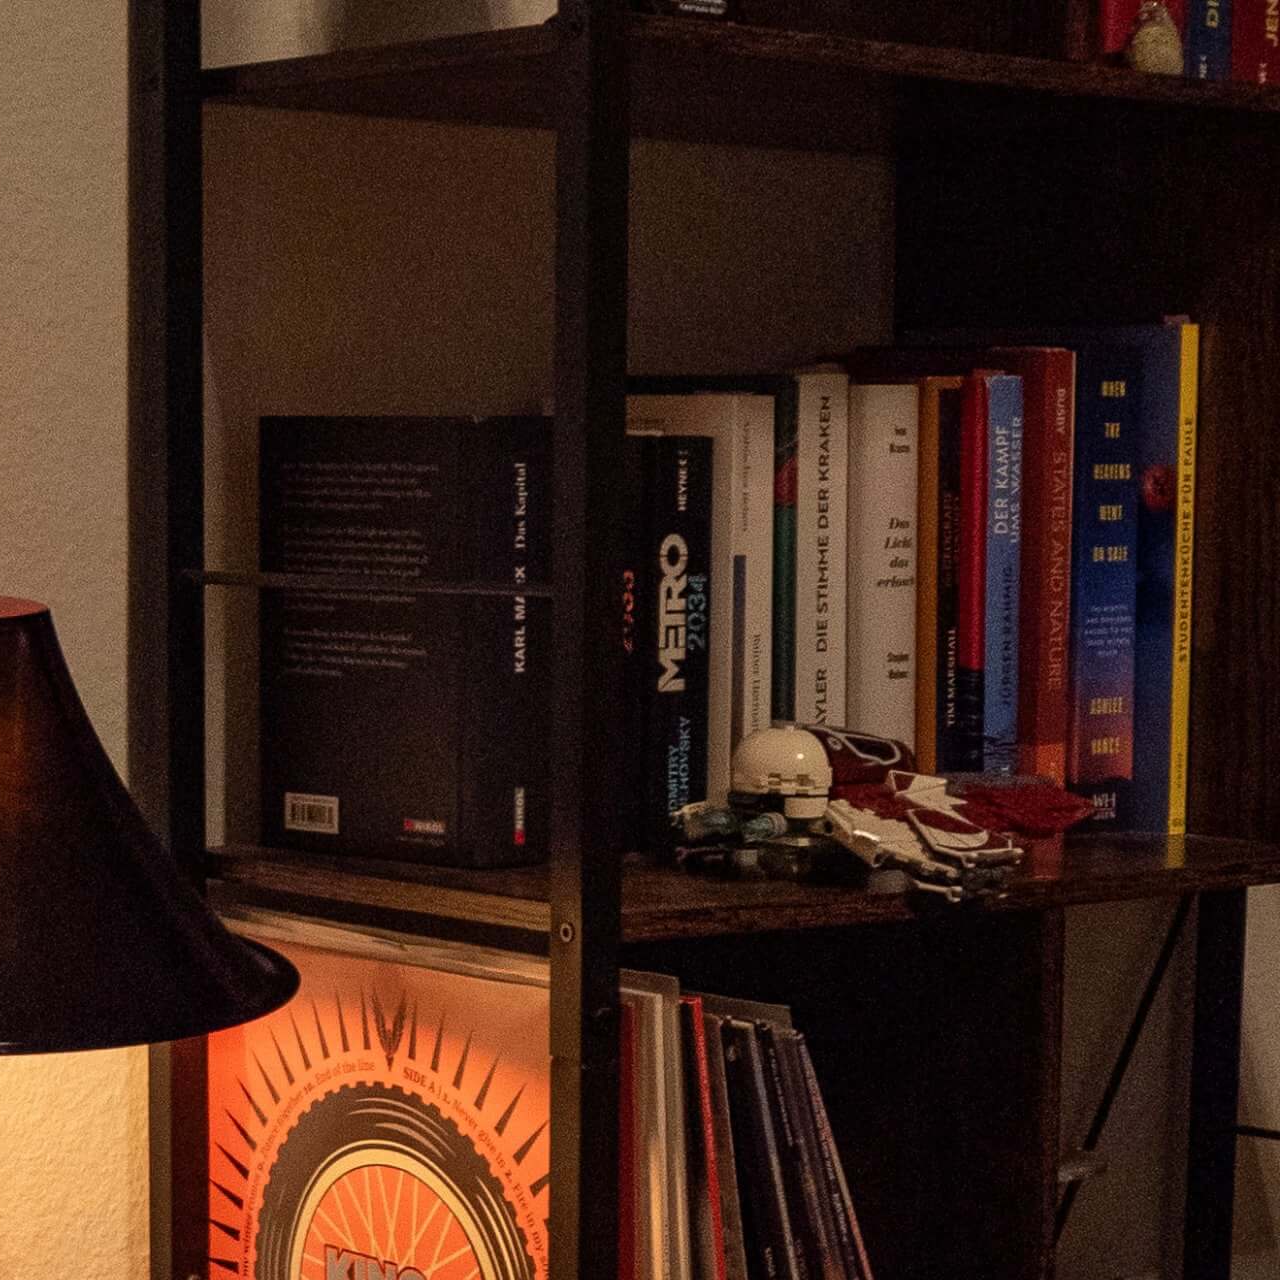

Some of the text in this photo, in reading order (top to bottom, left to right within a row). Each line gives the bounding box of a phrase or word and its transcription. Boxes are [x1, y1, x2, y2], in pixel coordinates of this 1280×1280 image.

[819, 396, 831, 482] KRAKEN
[818, 488, 829, 530] DER
[994, 425, 1010, 534] DER KAMPF
[1009, 416, 1024, 544] UMS WASSER
[1052, 452, 1067, 532] STATES
[817, 534, 829, 612] STIMME
[1049, 538, 1065, 592] AND
[514, 626, 526, 674] KARL
[657, 532, 689, 695] METRO
[687, 574, 708, 652] 2034
[816, 619, 828, 653] DIE
[1046, 600, 1064, 690] NATURE
[314, 1067, 331, 1087] End
[341, 1059, 356, 1075] the
[403, 1065, 426, 1089] SIDE
[427, 1077, 436, 1095] A
